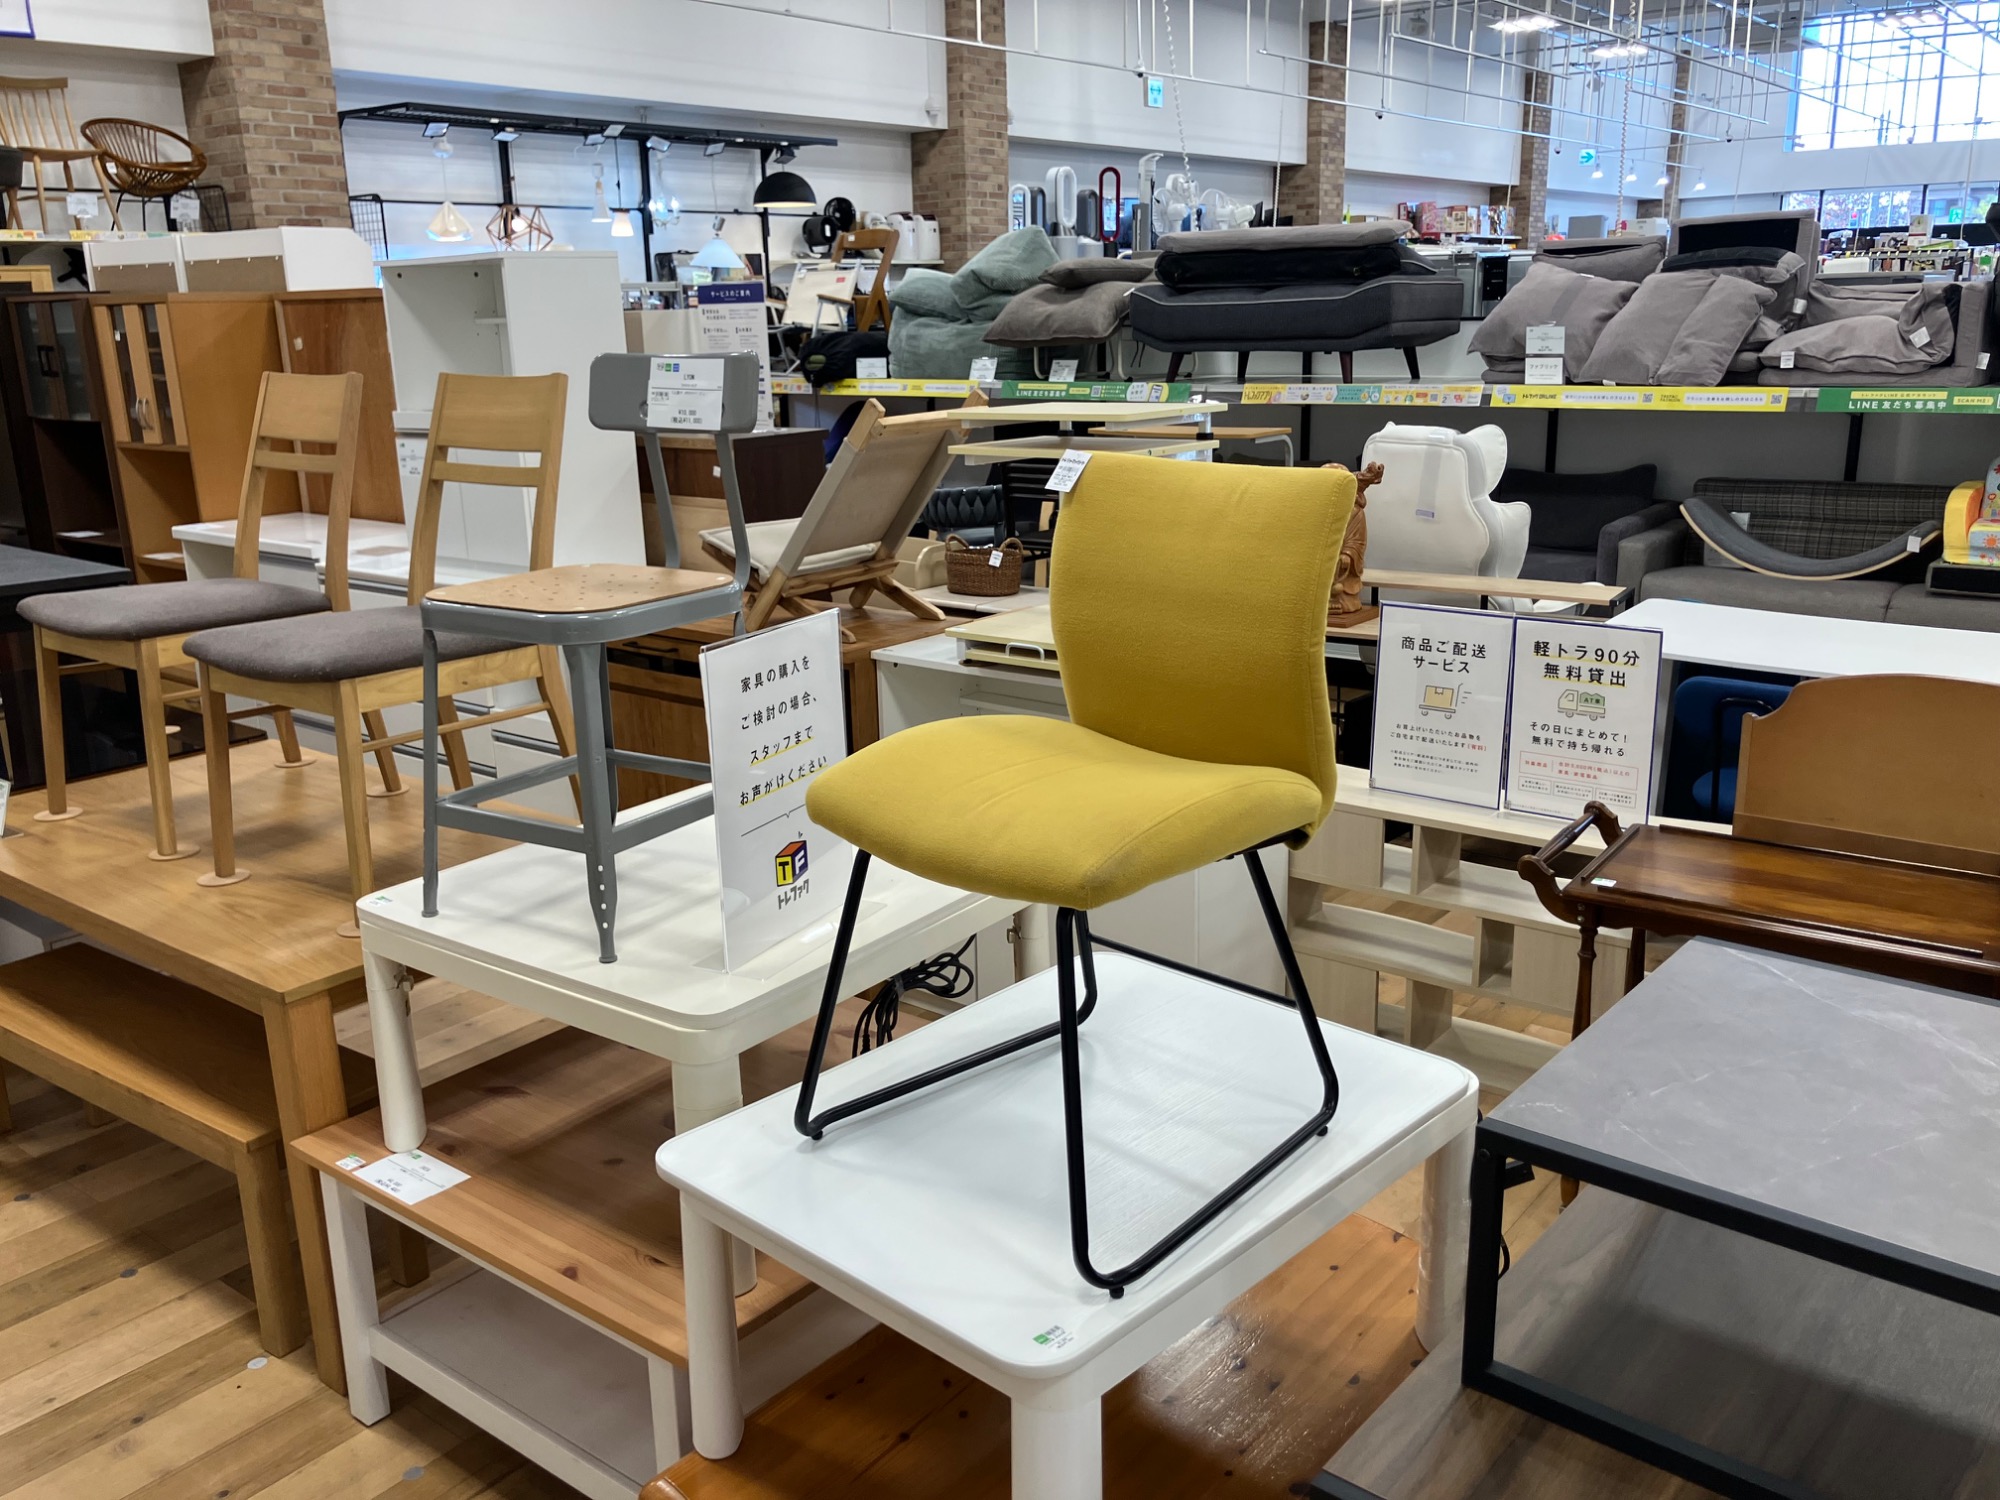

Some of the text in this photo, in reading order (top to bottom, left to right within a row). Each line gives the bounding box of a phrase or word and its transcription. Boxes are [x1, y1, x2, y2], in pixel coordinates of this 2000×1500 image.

[1401, 636, 1486, 659] 商品ご配送
[1534, 640, 1641, 667] 軽トラ90分
[740, 656, 811, 693] 家具の購入を
[1413, 656, 1470, 674] サービス
[1543, 662, 1627, 687] 無料貸出
[741, 691, 817, 730] ご検討の場合、
[750, 726, 814, 764] スタッフまで
[1531, 735, 1626, 757] 無料で持ち帰れる
[739, 756, 828, 806] お声がけください
[777, 878, 809, 910] トレファク
